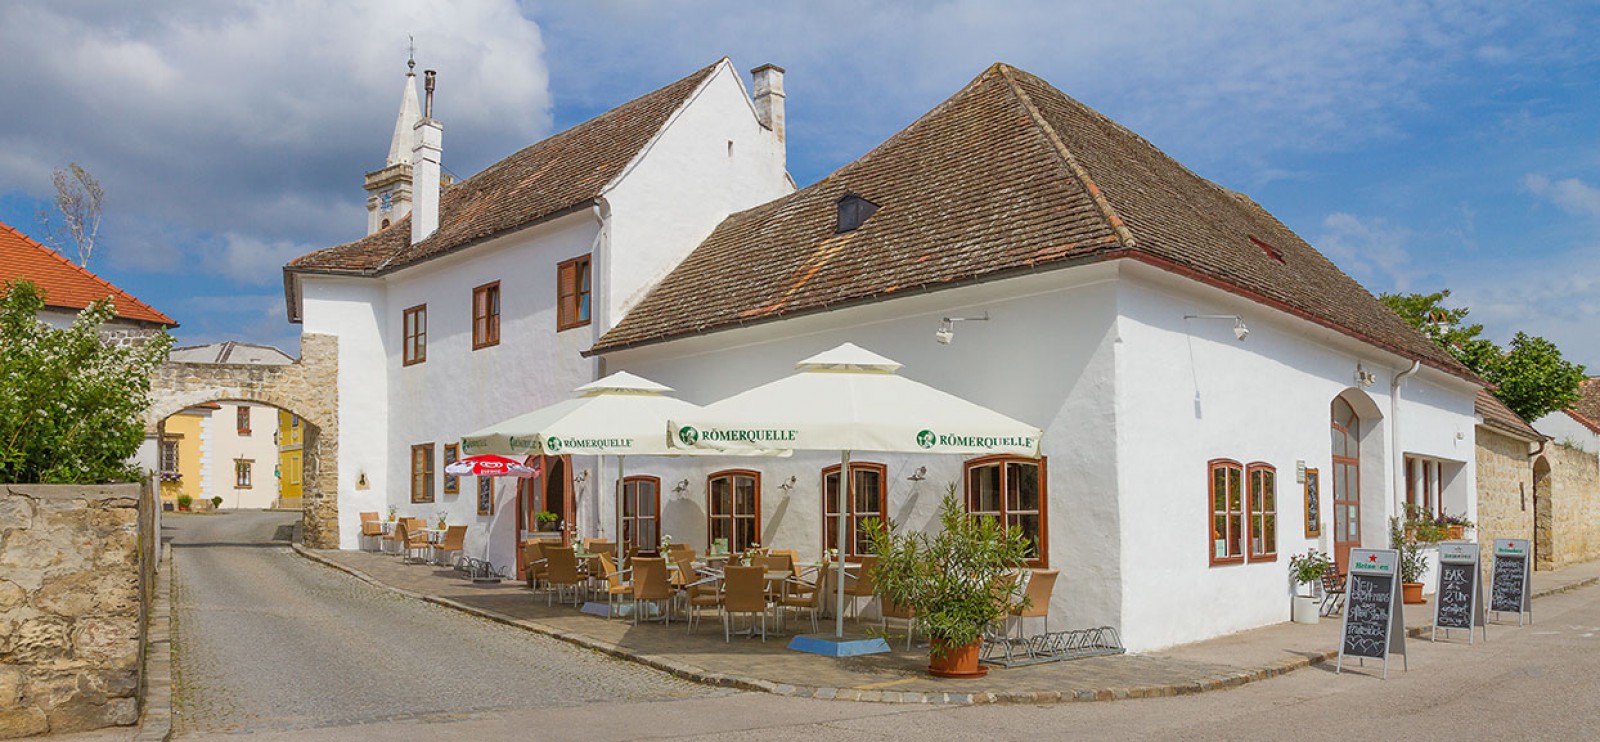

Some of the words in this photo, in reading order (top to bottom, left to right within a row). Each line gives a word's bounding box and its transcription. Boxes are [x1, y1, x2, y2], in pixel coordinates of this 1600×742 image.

[563, 436, 632, 450] RÖMERQUELLE
[702, 428, 796, 443] RÖMERQUELLE
[939, 432, 1033, 448] RÖMERQUELLE
[1443, 568, 1469, 584] BAR
